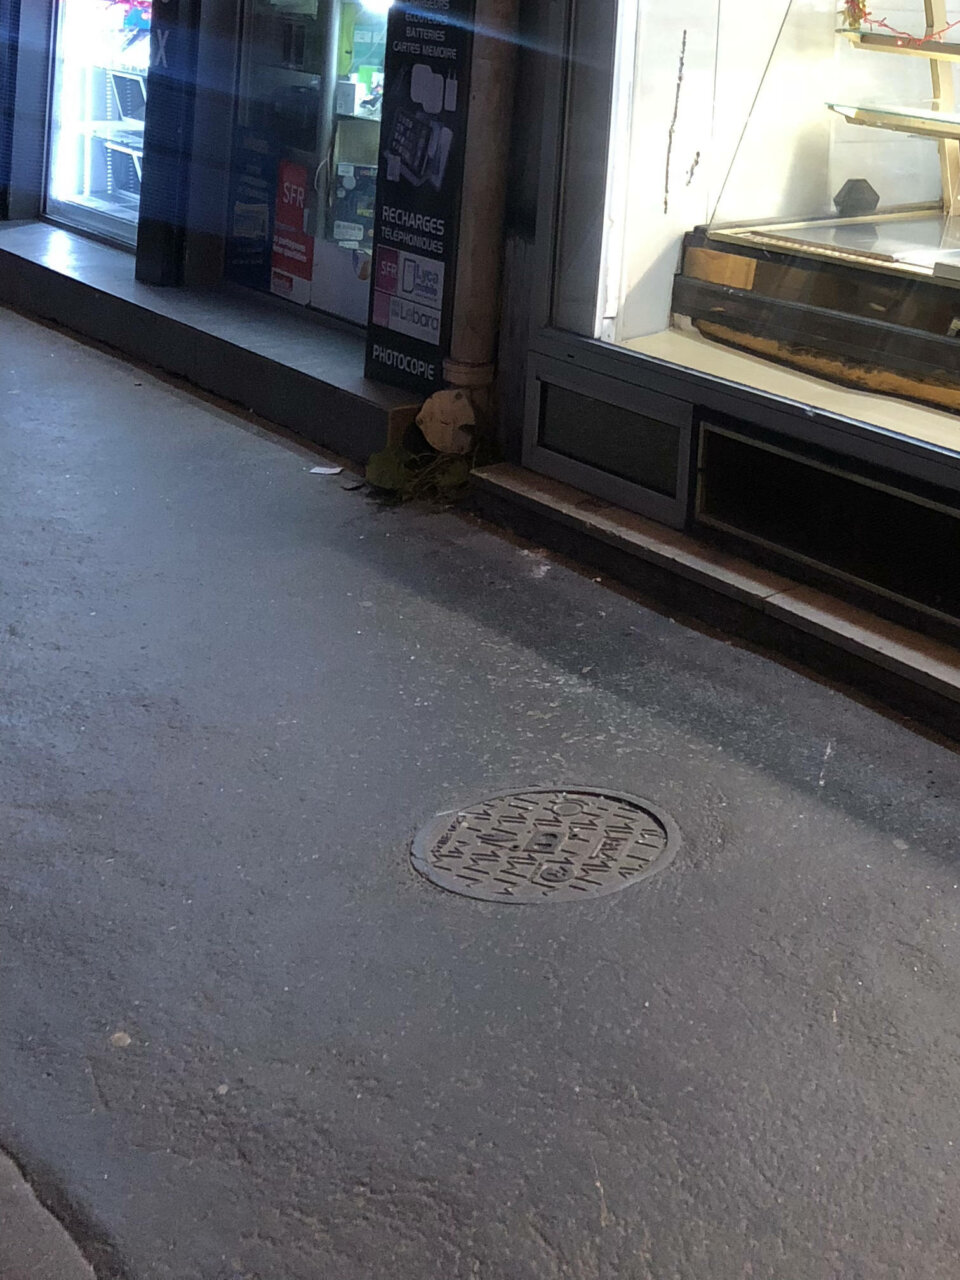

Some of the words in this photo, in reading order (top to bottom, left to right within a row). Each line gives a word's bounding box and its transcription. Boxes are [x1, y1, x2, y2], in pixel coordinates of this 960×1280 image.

[406, 26, 445, 42] BATTERIES
[393, 41, 420, 54] CARTES
[283, 182, 305, 208] SFR
[382, 205, 445, 236] RECHARGES
[381, 261, 397, 276] SFR
[416, 264, 439, 285] Lyca
[400, 302, 439, 331] Lebara
[373, 344, 435, 381] PHOTOCOPIE
